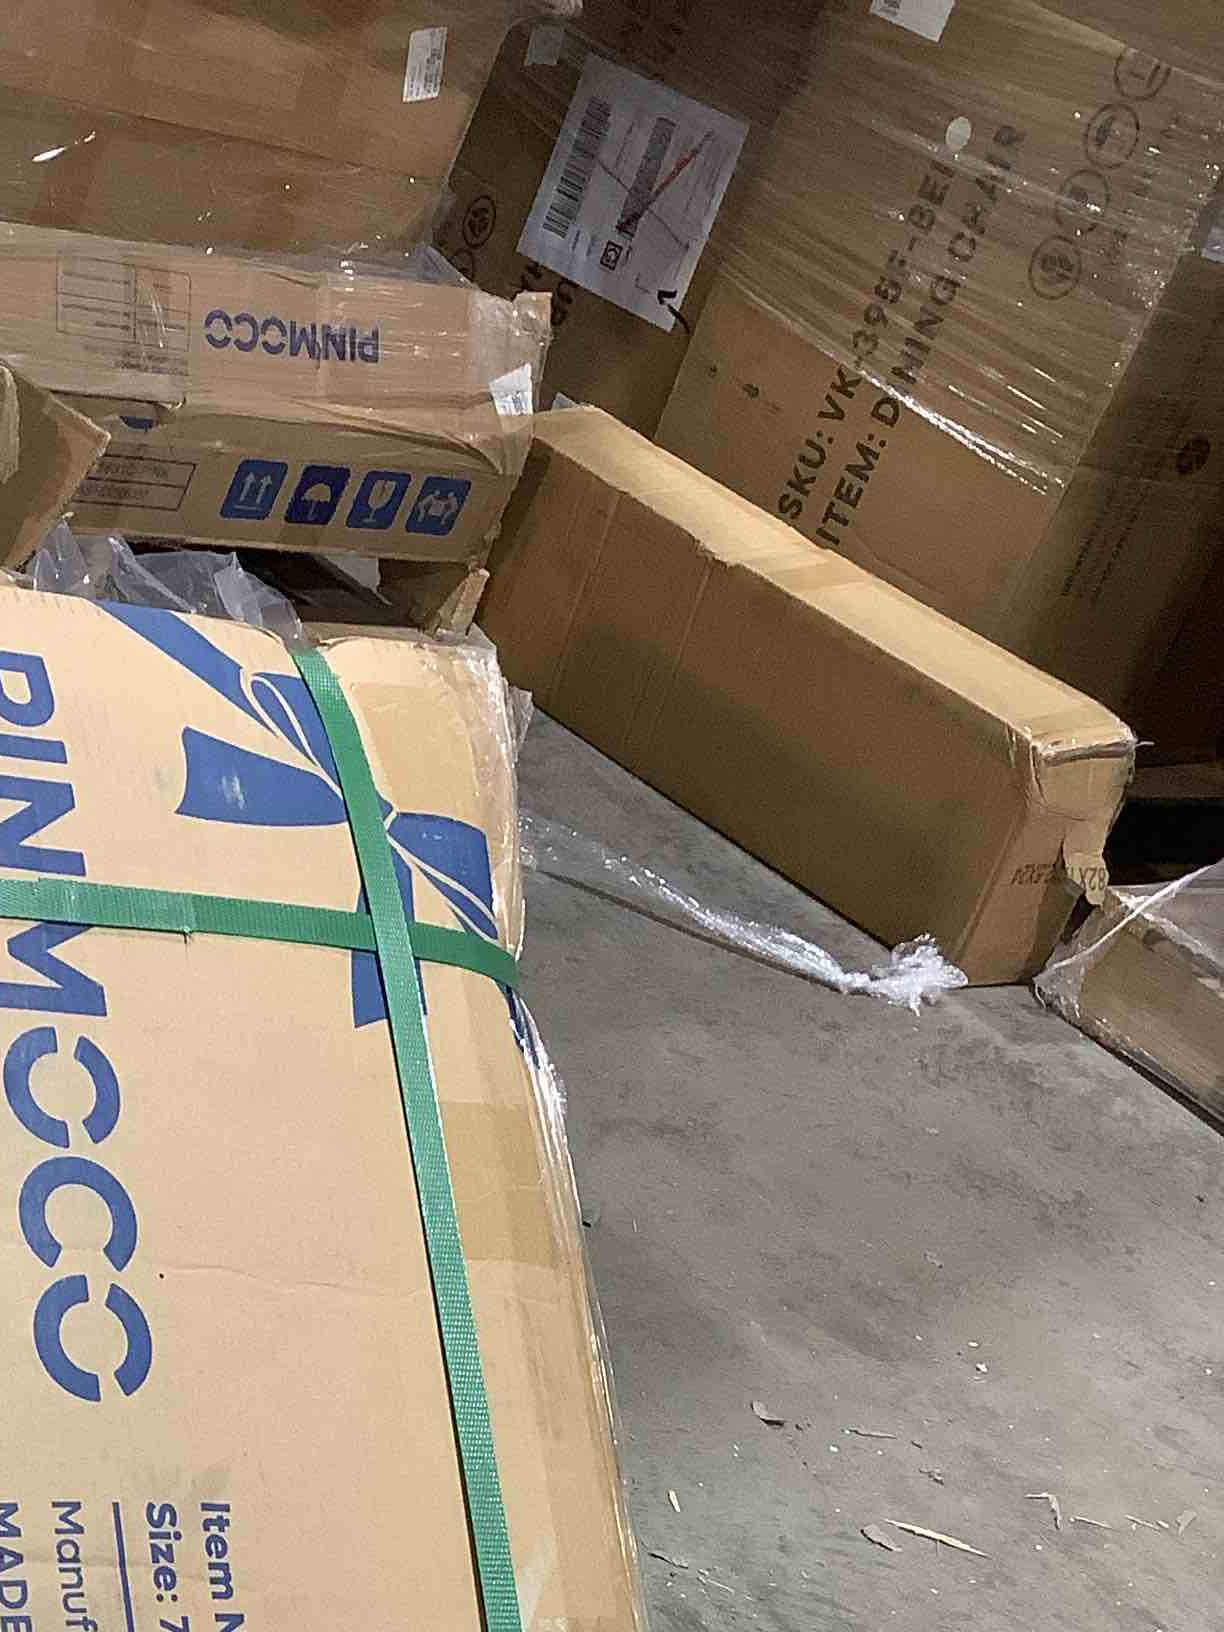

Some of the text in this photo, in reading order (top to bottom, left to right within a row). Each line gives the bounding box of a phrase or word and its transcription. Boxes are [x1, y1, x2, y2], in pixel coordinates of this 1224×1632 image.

[204, 308, 379, 364] PINMOCO
[815, 431, 886, 546] ITEM:
[871, 273, 962, 428] DNING
[777, 429, 834, 521] SKU:
[146, 1502, 178, 1603] Size:
[199, 1501, 233, 1600] Item
